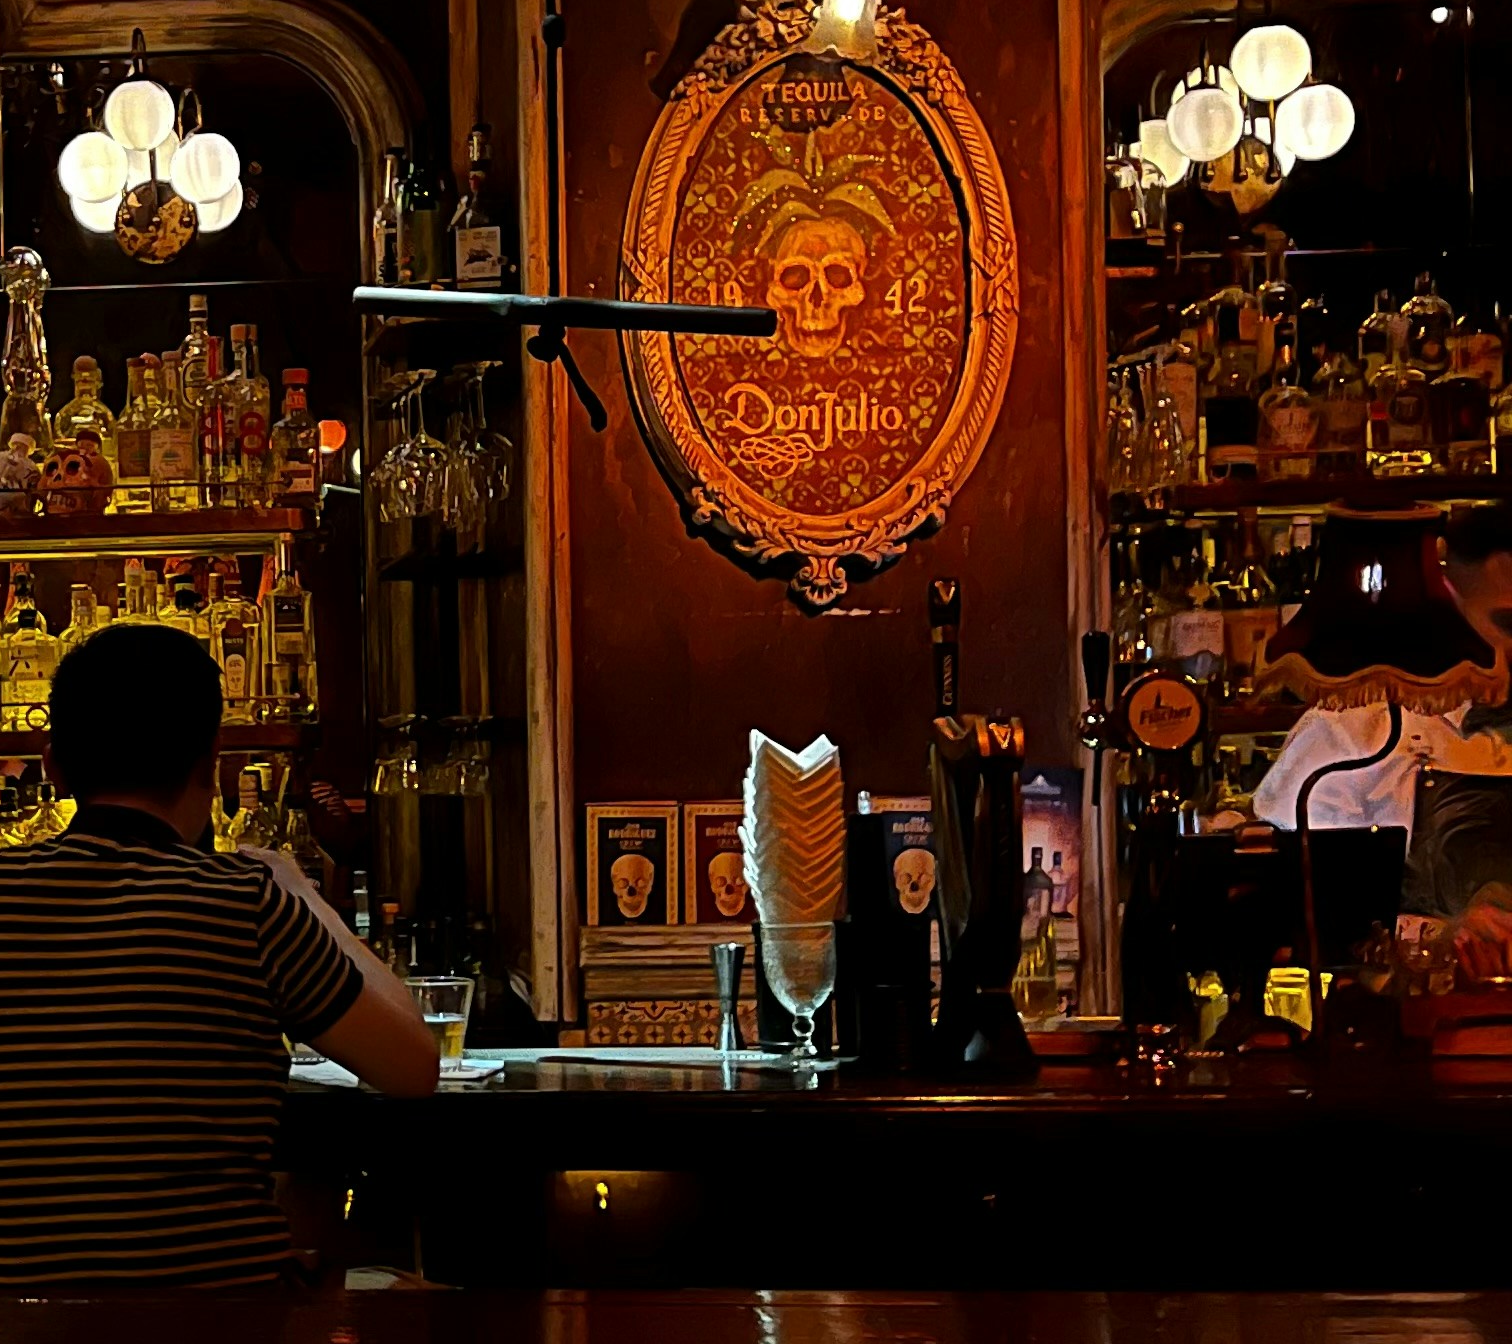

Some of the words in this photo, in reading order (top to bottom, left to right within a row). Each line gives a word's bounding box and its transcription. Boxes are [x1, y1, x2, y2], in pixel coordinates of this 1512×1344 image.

[760, 81, 868, 104] TEQUILA
[859, 106, 885, 122] DE
[885, 278, 927, 315] 42
